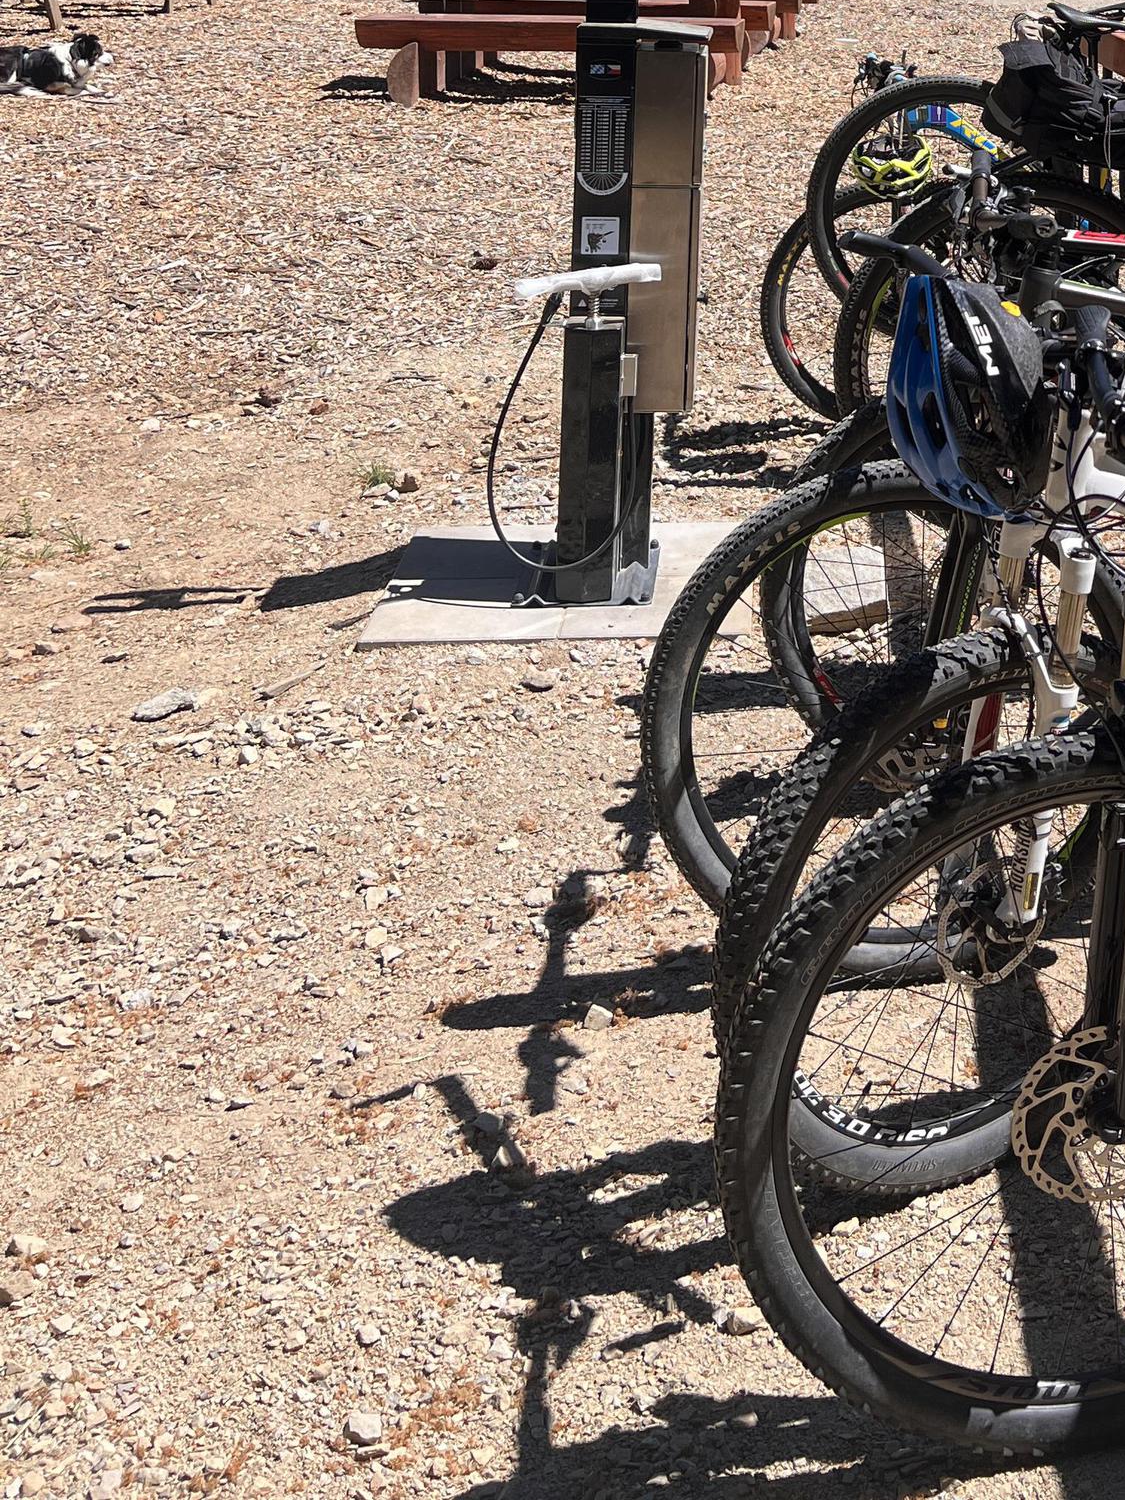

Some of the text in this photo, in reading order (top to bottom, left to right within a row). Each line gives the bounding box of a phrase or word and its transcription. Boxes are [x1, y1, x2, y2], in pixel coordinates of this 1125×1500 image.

[852, 308, 867, 397] MAXXIS
[964, 311, 1000, 376] MET
[706, 521, 800, 616] MAXXIS
[968, 671, 1009, 689] FAST
[822, 1104, 872, 1136] 3.0
